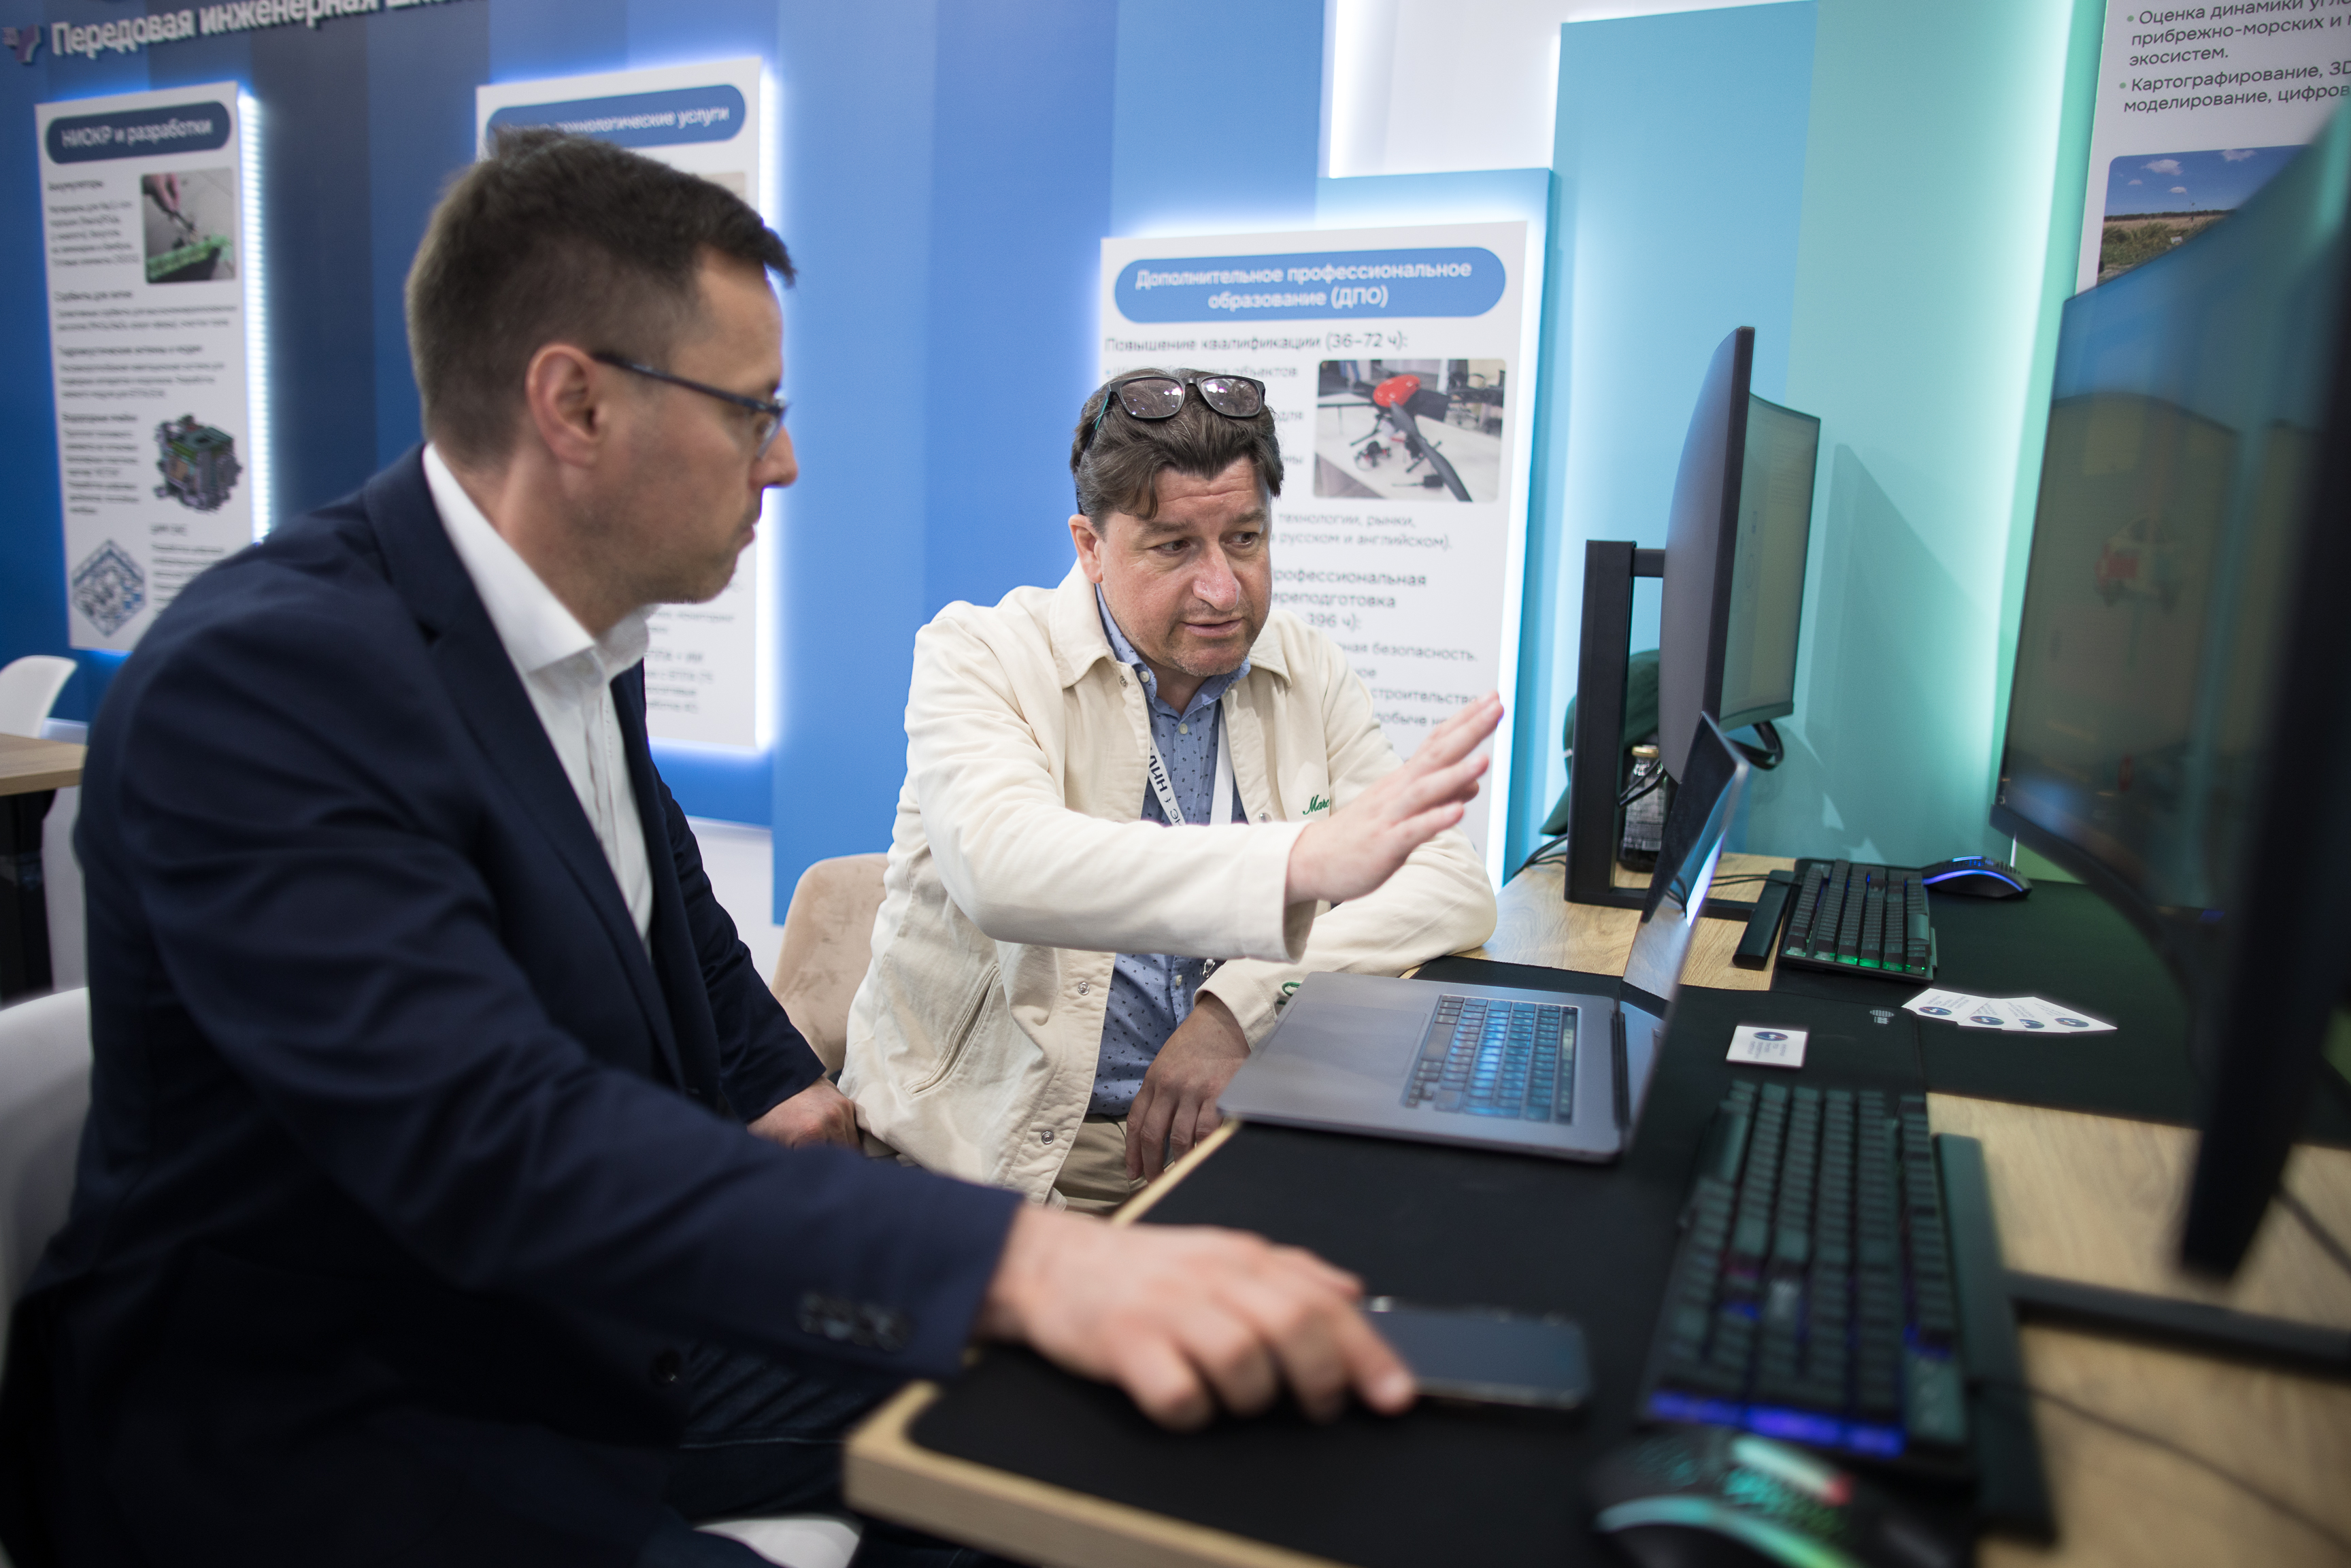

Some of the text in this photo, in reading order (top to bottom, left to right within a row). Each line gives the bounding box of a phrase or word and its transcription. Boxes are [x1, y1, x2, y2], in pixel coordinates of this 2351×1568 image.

[2139, 7, 2205, 26] Оценка
[2210, 0, 2303, 20] динамики
[51, 10, 196, 59] Передовая
[2131, 16, 2342, 48] прибрежно-морских и
[2129, 47, 2229, 67] экосистем.
[2131, 66, 2324, 93] Картографирование,
[2123, 91, 2272, 113] моделирование,
[127, 118, 213, 147] разработки
[1135, 261, 1472, 290] Дополнительное профессиональное
[1207, 284, 1389, 312] образование (ДПО)
[1105, 338, 1196, 352] Повышение
[1201, 333, 1320, 352] квалификации
[1278, 512, 1416, 529] технологии, рынки,
[1279, 533, 1339, 546] русском
[1344, 535, 1353, 544] и
[1357, 533, 1453, 552] английском).
[1271, 567, 1427, 588] рофессиональная
[1271, 591, 1397, 608] ереподготовка
[1372, 641, 1478, 662] безопасность.
